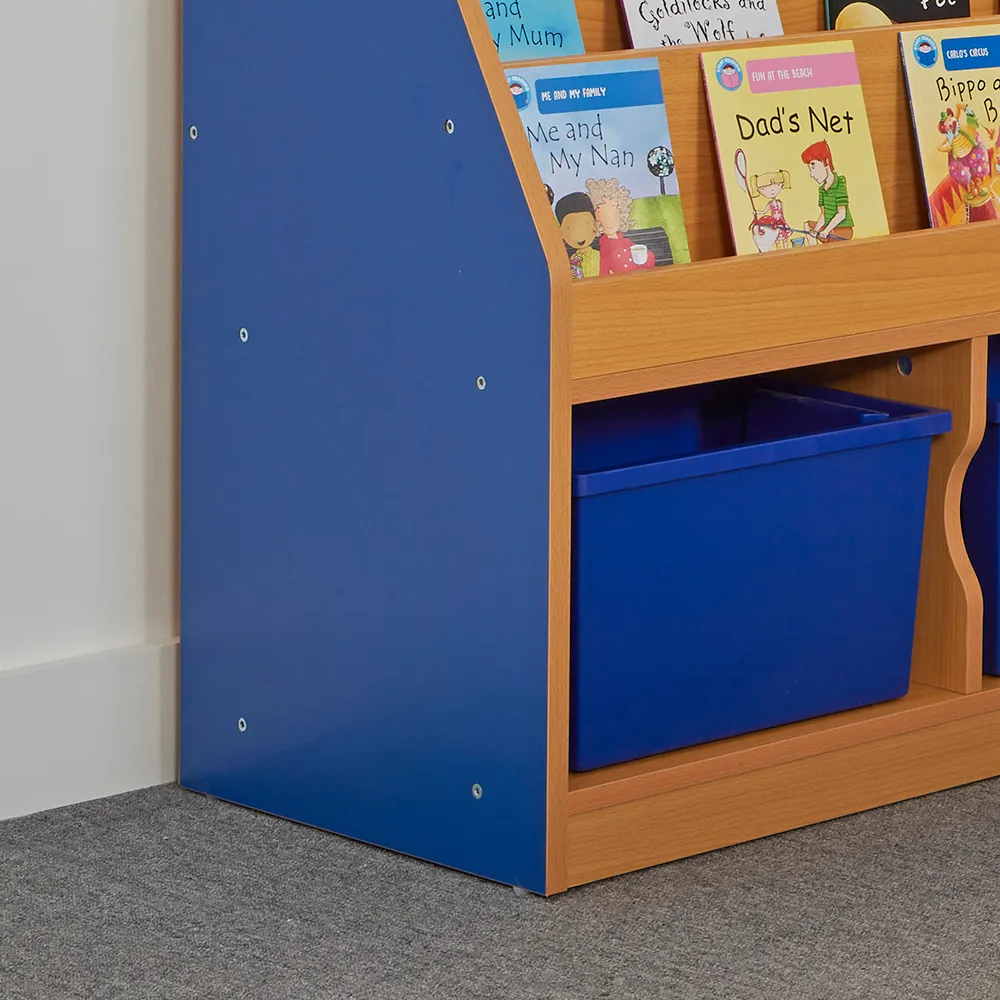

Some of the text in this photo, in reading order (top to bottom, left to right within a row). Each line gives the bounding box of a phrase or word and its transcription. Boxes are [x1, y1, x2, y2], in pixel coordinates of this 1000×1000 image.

[493, 24, 564, 54] y Mum
[684, 18, 736, 42] Wolf
[946, 48, 989, 60] CARLO'S CIRCUS
[752, 68, 813, 82] FUN AT THE BEACH
[541, 86, 607, 102] ME AND MY FAMILY
[936, 76, 986, 102] Bippo
[526, 113, 604, 148] Me and
[736, 106, 854, 141] Dad's Net
[550, 144, 634, 177] My Nan
